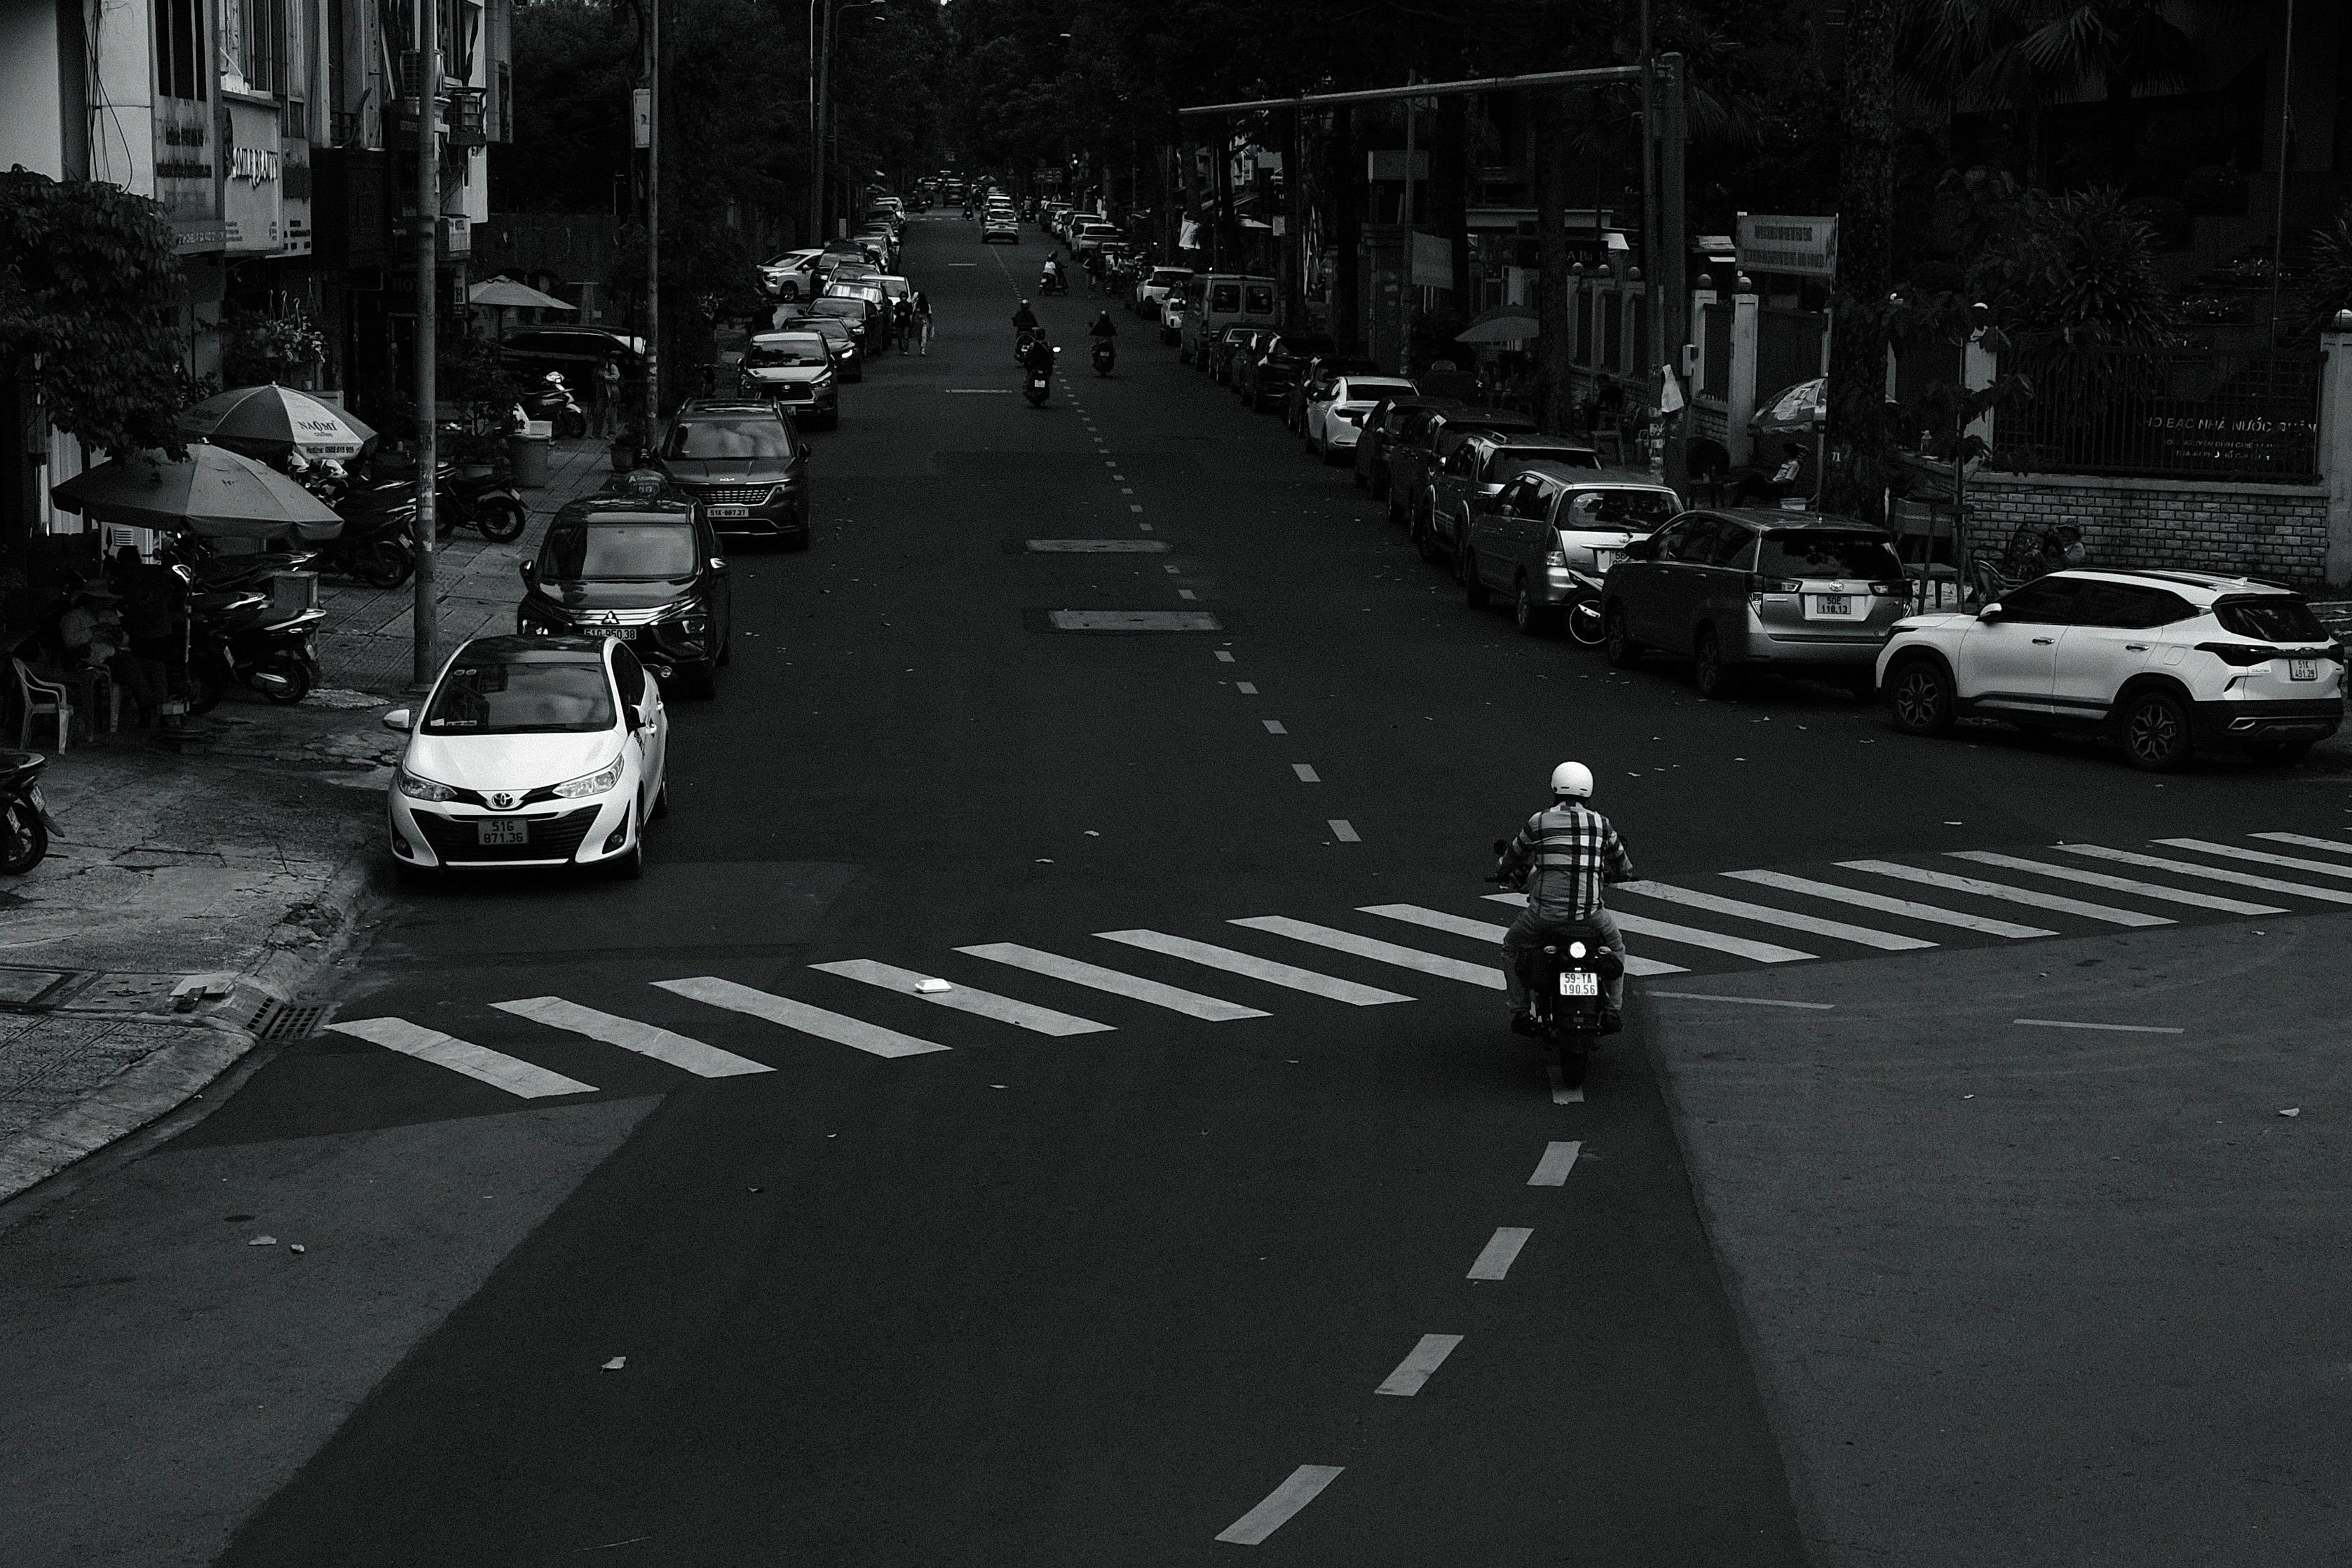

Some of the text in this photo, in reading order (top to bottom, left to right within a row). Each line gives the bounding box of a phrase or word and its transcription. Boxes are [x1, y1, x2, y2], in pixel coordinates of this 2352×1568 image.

[298, 421, 337, 431] NAOMI
[492, 821, 514, 831] 51G
[484, 833, 524, 843] 871.36
[1564, 973, 1593, 984] 59-TA
